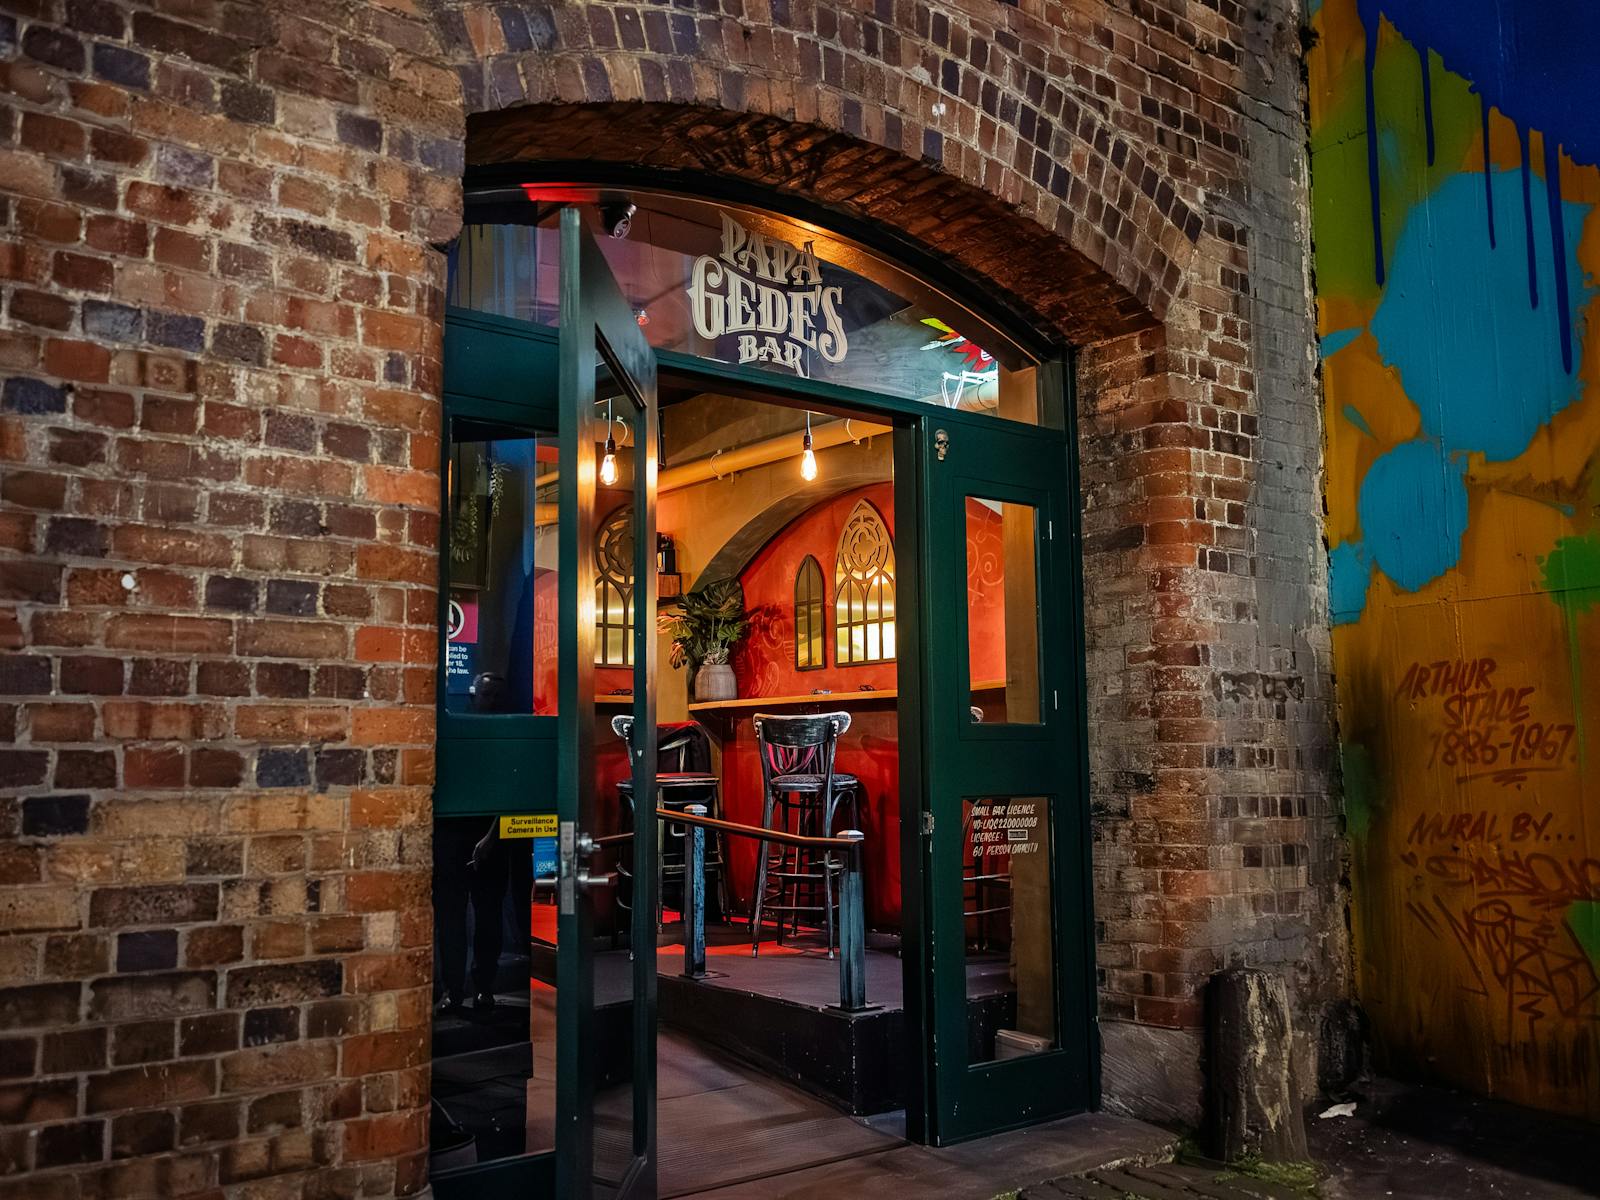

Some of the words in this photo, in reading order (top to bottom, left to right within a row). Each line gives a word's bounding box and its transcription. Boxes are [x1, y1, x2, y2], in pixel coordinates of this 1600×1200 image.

[719, 210, 823, 286] PAPA
[738, 334, 808, 378] BAR
[459, 645, 467, 653] be
[1394, 657, 1497, 699] ARTHUR
[1443, 686, 1535, 729] STACE
[971, 805, 990, 817] SMALL
[992, 805, 1005, 816] BAR
[1007, 804, 1035, 815] LICENCE
[511, 817, 554, 825] Surveillance
[507, 826, 534, 834] Camera
[1407, 811, 1501, 845] MURAL
[1510, 811, 1576, 842] BY...
[970, 831, 1004, 843] LICENSEE:
[972, 845, 984, 857] 60
